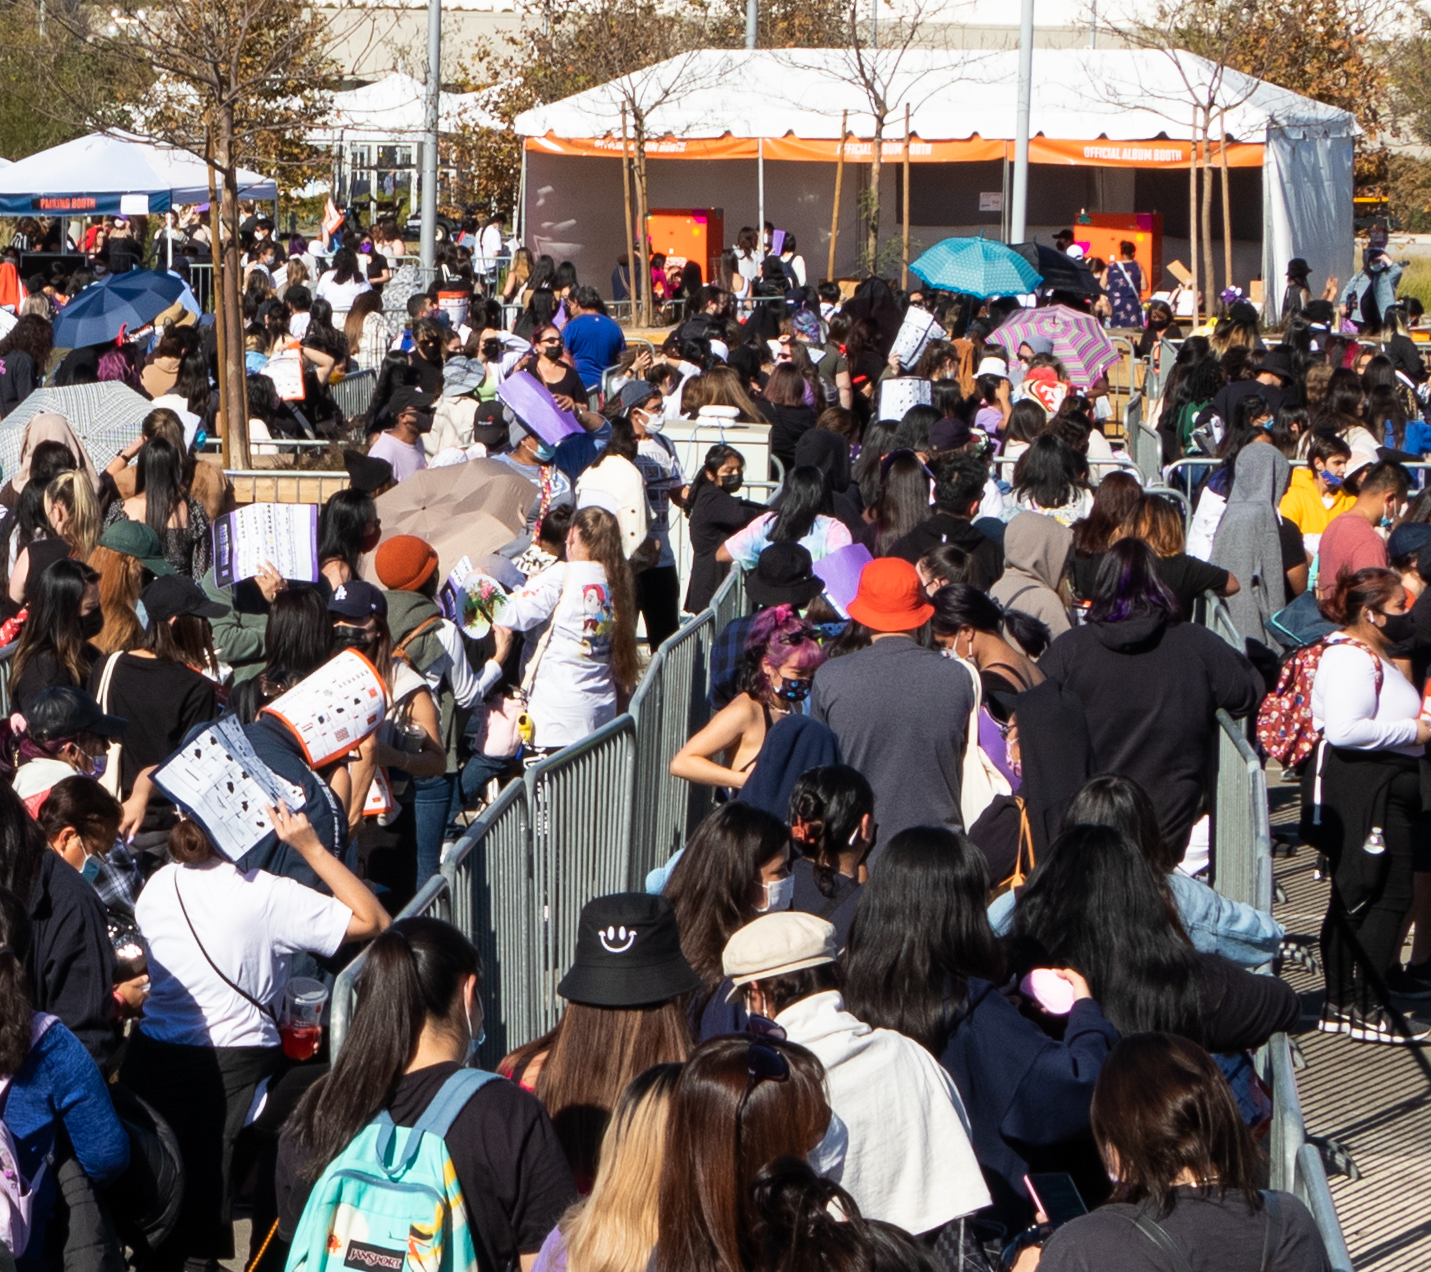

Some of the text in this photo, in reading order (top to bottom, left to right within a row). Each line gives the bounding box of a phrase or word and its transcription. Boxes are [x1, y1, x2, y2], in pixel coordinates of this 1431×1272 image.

[907, 142, 933, 155] OOTH
[1084, 146, 1182, 161] OFFICIAL ALBUM BOOTH
[40, 197, 96, 210] PAIRING BOOTH
[348, 1247, 403, 1270] JANSPORT
